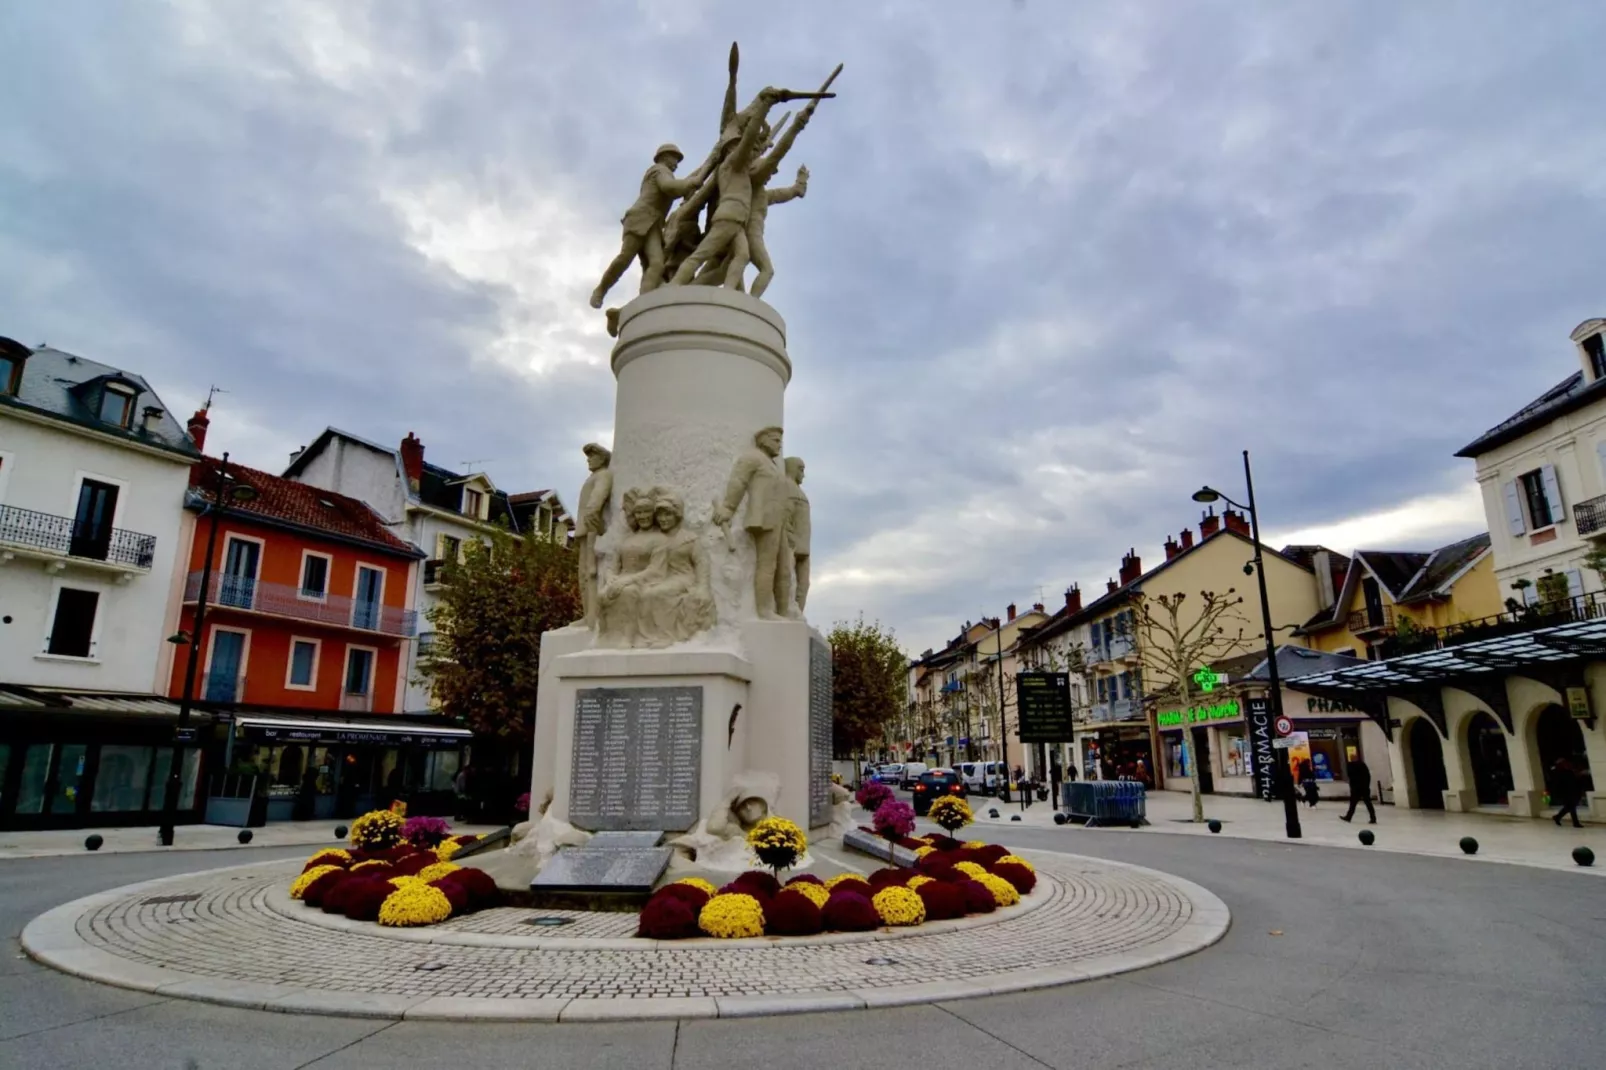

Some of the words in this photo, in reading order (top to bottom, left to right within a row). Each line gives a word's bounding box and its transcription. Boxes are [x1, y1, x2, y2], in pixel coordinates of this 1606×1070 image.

[1197, 704, 1208, 720] du
[265, 728, 277, 737] bar
[336, 732, 345, 740] LA
[346, 732, 388, 741] PROMENADE
[1252, 701, 1272, 799] PHARMACIE
